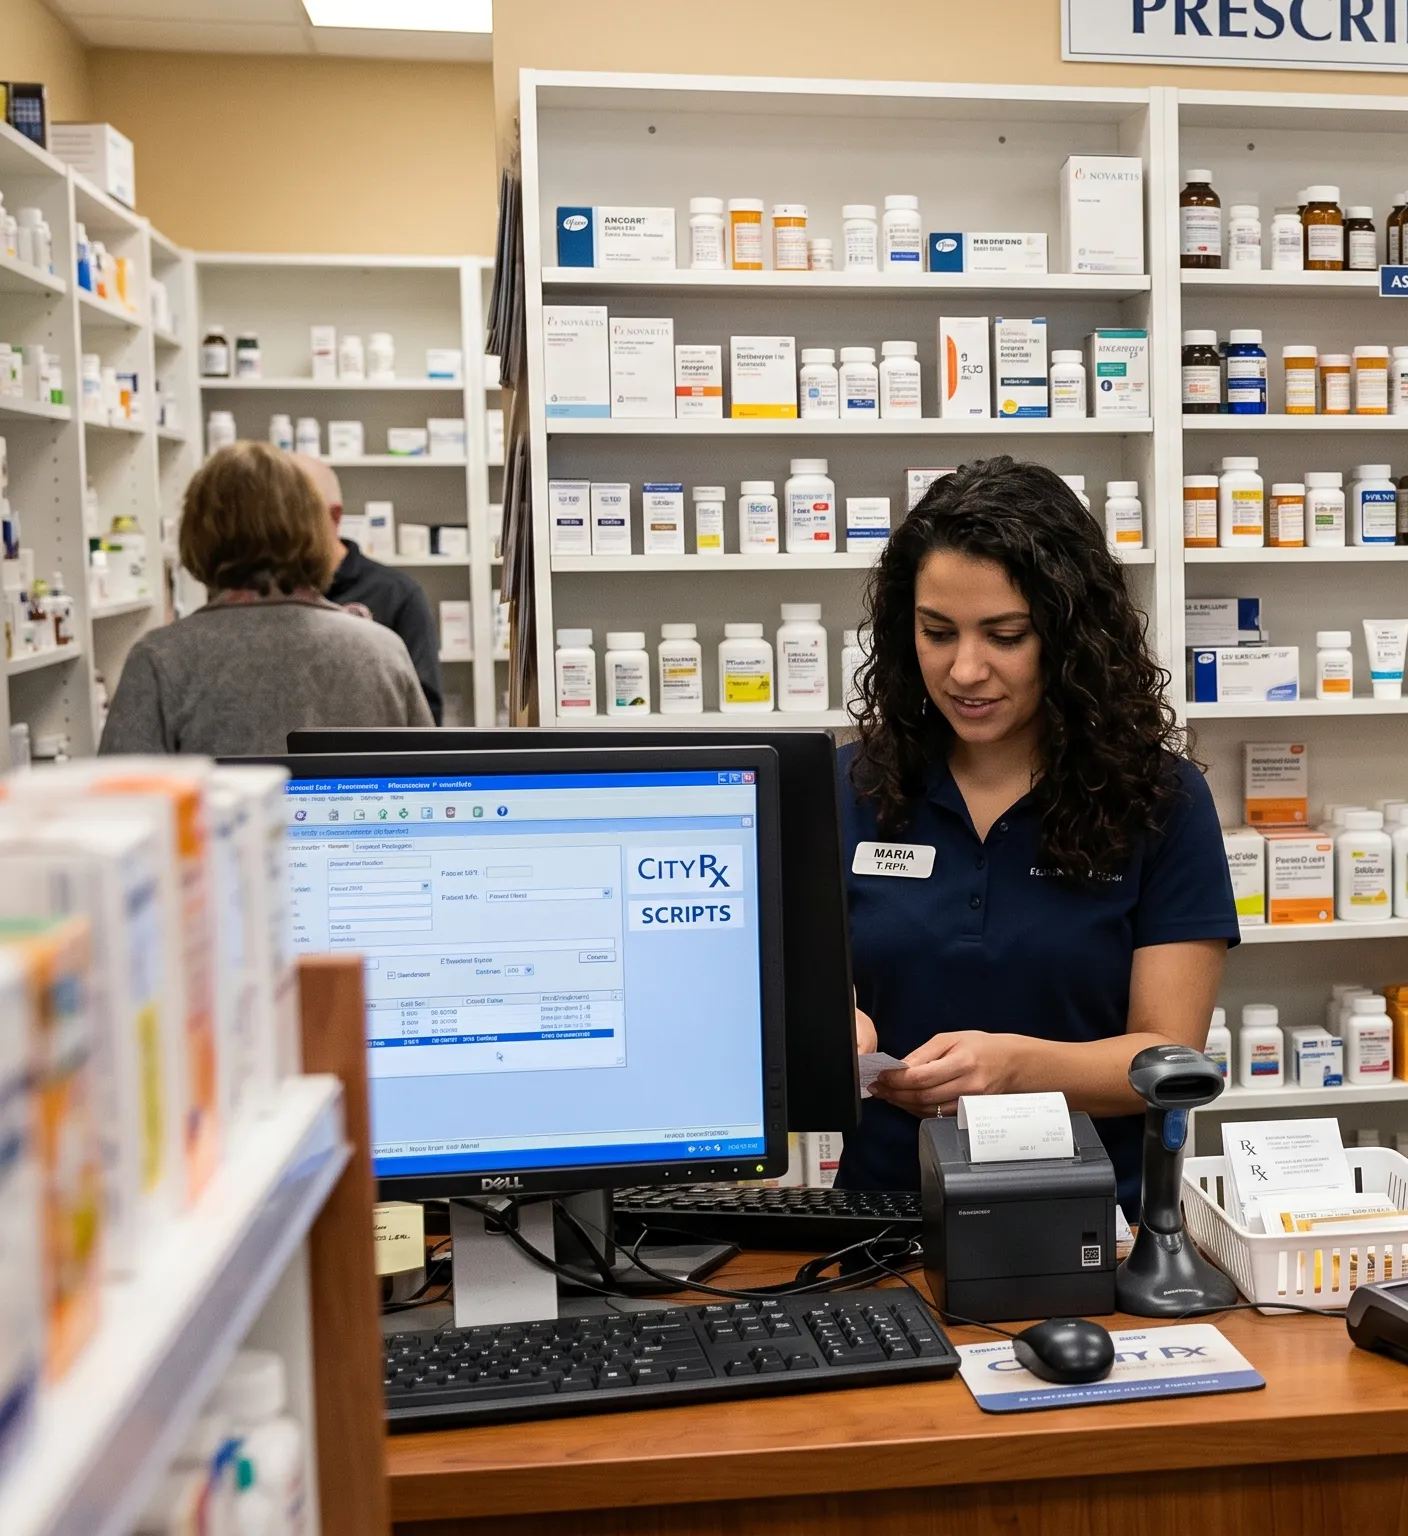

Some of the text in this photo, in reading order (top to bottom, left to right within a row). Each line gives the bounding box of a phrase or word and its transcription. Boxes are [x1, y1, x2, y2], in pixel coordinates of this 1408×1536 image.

[1090, 172, 1139, 181] NOVARTIS
[873, 848, 915, 860] MARIA
[641, 904, 731, 925] SCRIPTS
[481, 1175, 524, 1191] DELL
